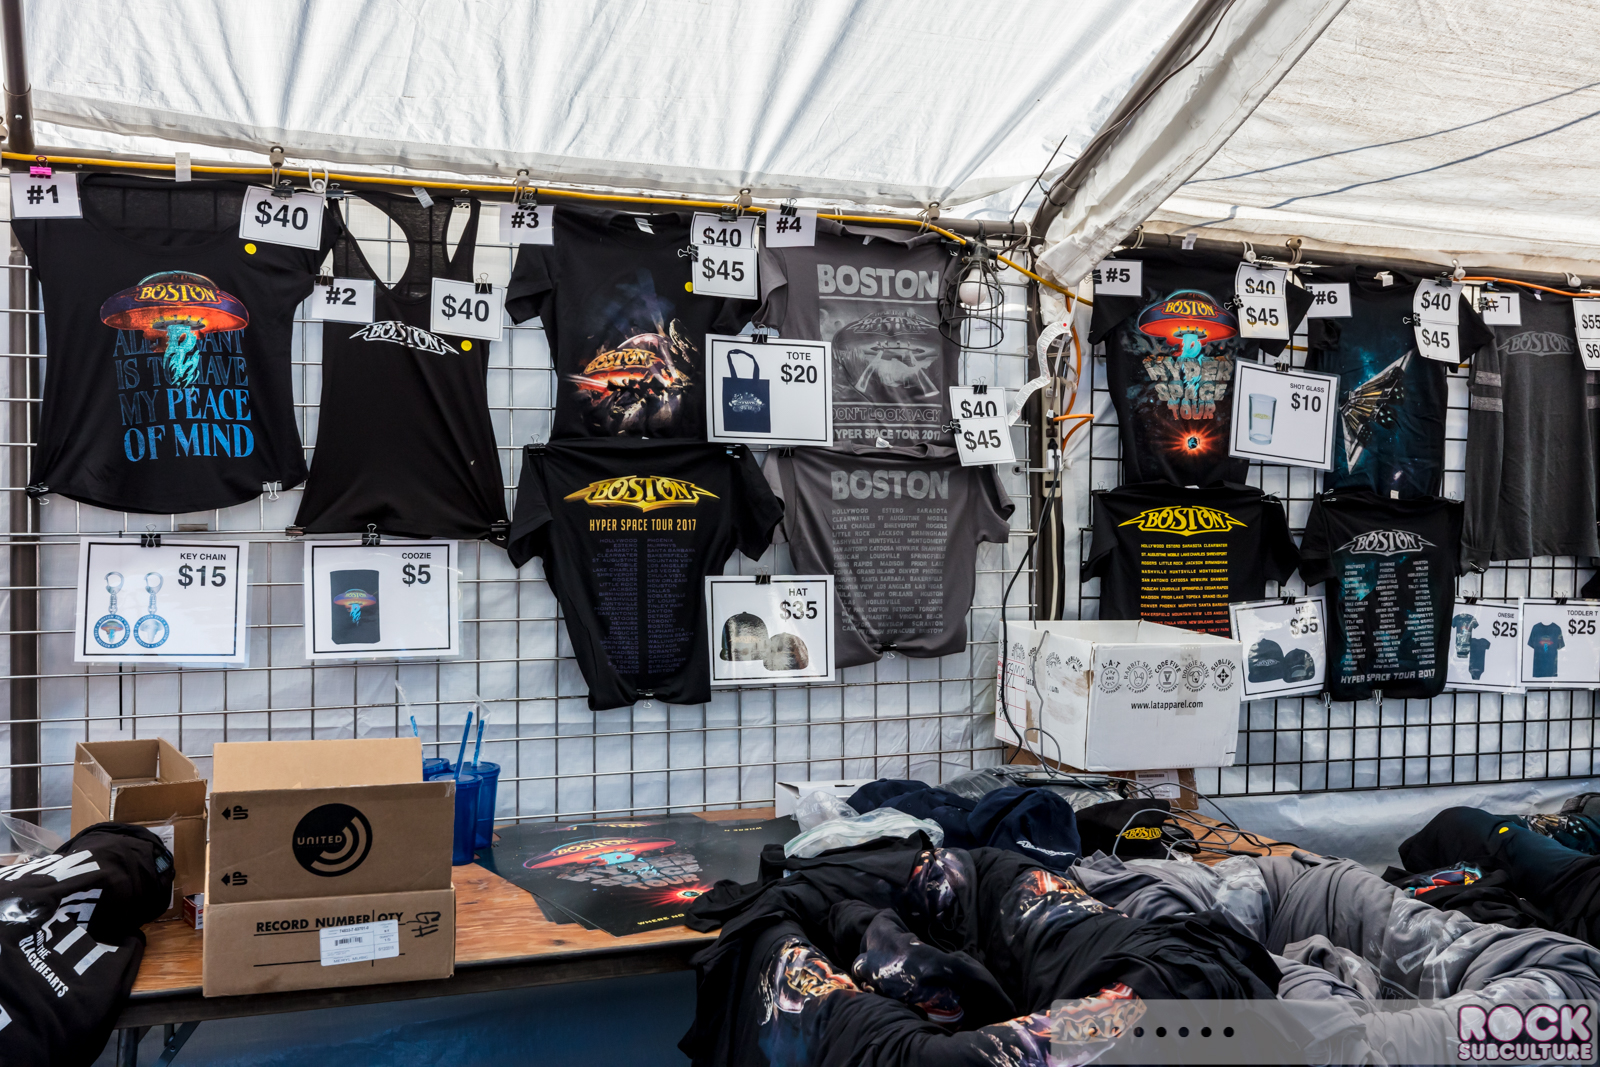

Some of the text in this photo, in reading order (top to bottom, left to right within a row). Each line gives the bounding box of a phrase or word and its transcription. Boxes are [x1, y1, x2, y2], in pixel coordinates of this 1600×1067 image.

[27, 184, 59, 205] #1
[254, 199, 309, 231] $40
[511, 211, 539, 229] #3
[776, 217, 801, 234] #4
[703, 226, 742, 247] $40
[702, 257, 745, 282] $45
[1106, 268, 1131, 282] #5
[817, 263, 939, 298] BOSTON
[1245, 277, 1276, 295] $40
[139, 283, 217, 303] BOSTON
[326, 286, 357, 305] #2
[1316, 290, 1338, 305] #6
[1420, 290, 1451, 311] $40
[441, 294, 489, 322] $40
[1164, 301, 1215, 316] BOSTON
[1246, 307, 1279, 327] $45
[367, 321, 443, 352] BOSTON
[1422, 330, 1450, 349] $45
[1510, 332, 1571, 352] BOSTON
[584, 349, 656, 374] BOSTON
[786, 352, 811, 361] TOTE
[115, 357, 140, 390] IS
[781, 363, 818, 385] $20
[1143, 356, 1234, 381] HYPER
[1155, 383, 1228, 401] SPACE
[1306, 385, 1324, 393] GLASS
[118, 388, 251, 426] MY PEACE
[960, 399, 997, 419] $40
[1167, 400, 1216, 420] TOUR
[1291, 392, 1322, 412] $10
[868, 408, 907, 422] LOOK
[124, 423, 255, 462] OF MIND
[833, 429, 940, 440] YPER SPACE TOUR 2017
[963, 429, 1001, 452] $45
[588, 476, 696, 503] BOSTON
[830, 469, 951, 500] BOSTON
[590, 519, 697, 531] HYPER SPACE TOUR 2017
[1143, 507, 1228, 531] BOSTON
[1354, 531, 1418, 551] BOSTON
[200, 553, 226, 561] CHAIN
[401, 552, 431, 560] COOZIE
[178, 563, 226, 589] $15
[402, 563, 431, 587] $5
[788, 588, 808, 596] HAT
[780, 600, 817, 622] $35
[1290, 617, 1318, 635] $35
[1492, 620, 1518, 638] $25
[1568, 618, 1596, 636] $25
[1124, 661, 1154, 680] RABBIT SKINS
[1154, 659, 1181, 674] CODE FIVE
[1182, 660, 1209, 679] DOGGIE SKINS
[1211, 659, 1236, 671] SUBLIVIE
[1341, 669, 1436, 684] HYPER SPACE TOUR 2017
[1131, 700, 1204, 710] www.latapparel.com
[233, 805, 249, 820] UP
[296, 835, 343, 846] UNITED
[556, 838, 634, 855] BOSTON
[232, 871, 248, 886] UP
[256, 919, 309, 932] RECORD
[315, 914, 370, 928] NUMBER
[637, 916, 669, 925] WHERE
[38, 946, 51, 960] THE
[19, 934, 69, 998] BLACKHEARTS
